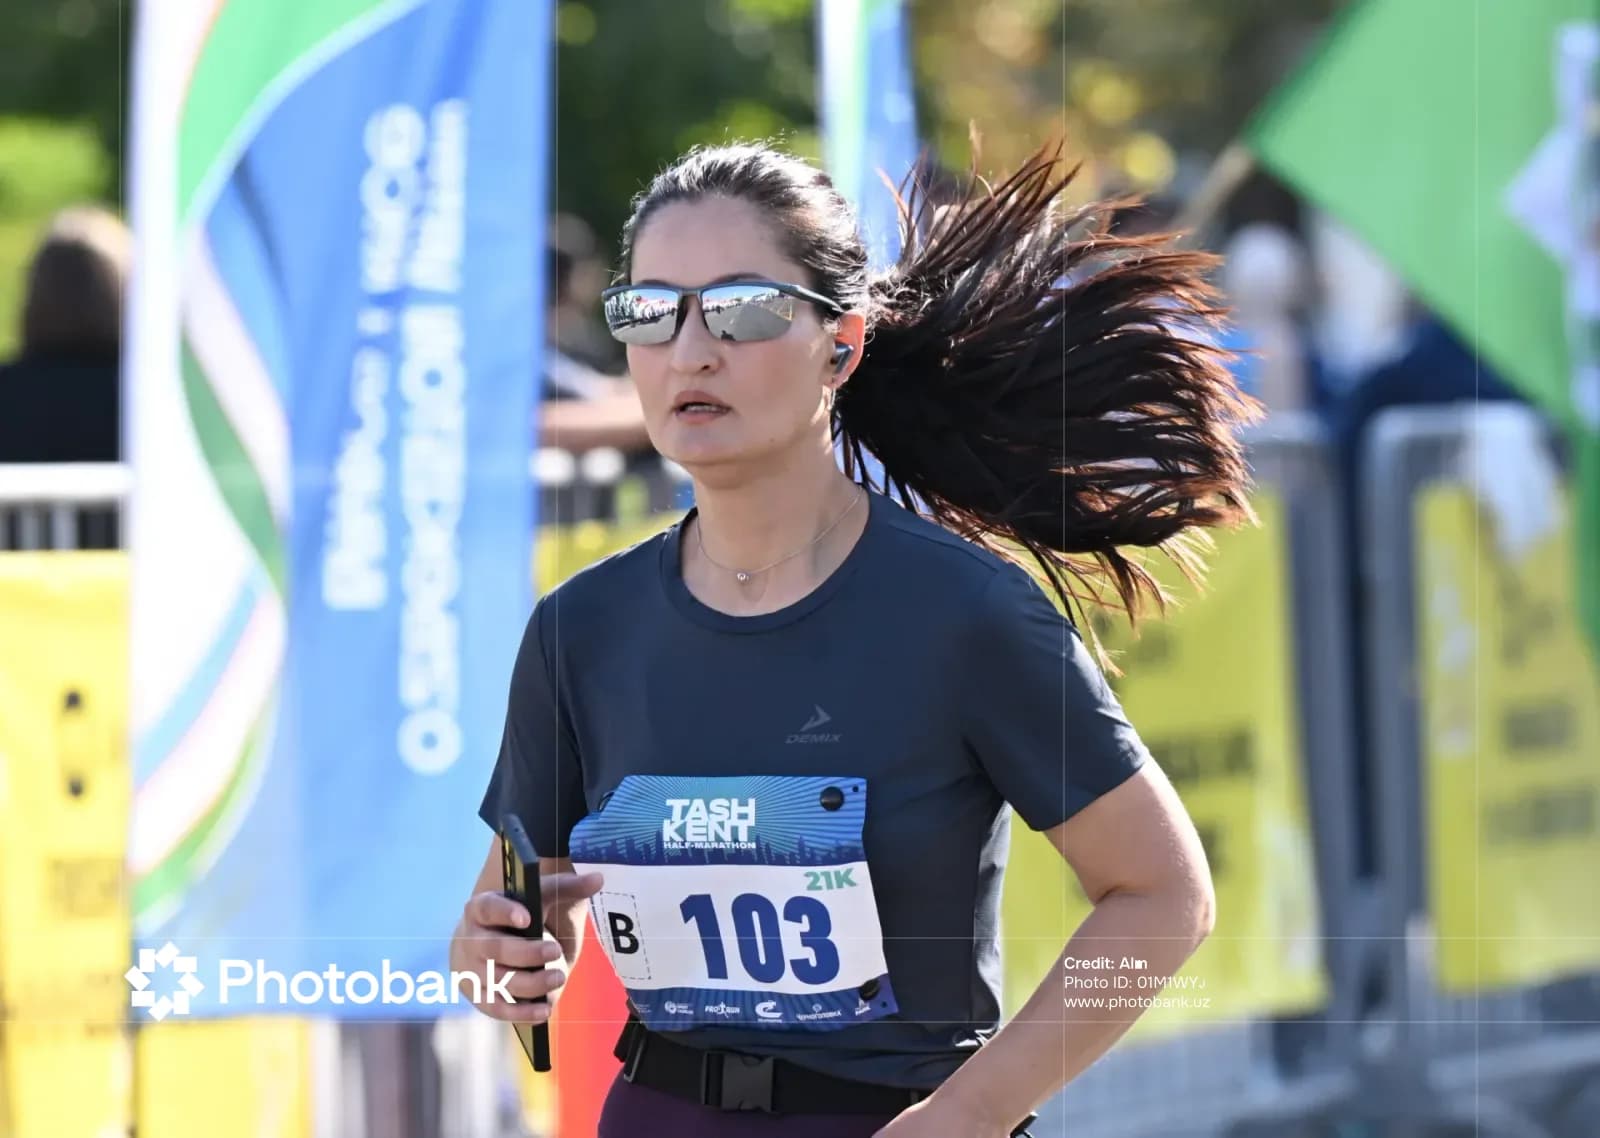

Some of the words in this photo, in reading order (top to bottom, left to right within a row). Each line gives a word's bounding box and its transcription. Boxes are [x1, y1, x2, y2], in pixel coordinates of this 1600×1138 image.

[665, 798, 755, 826] TASH
[662, 819, 749, 842] KENT
[663, 841, 757, 849] HALF-MARATHON
[803, 868, 857, 891] 21K
[607, 911, 640, 955] B
[679, 893, 840, 985] 103
